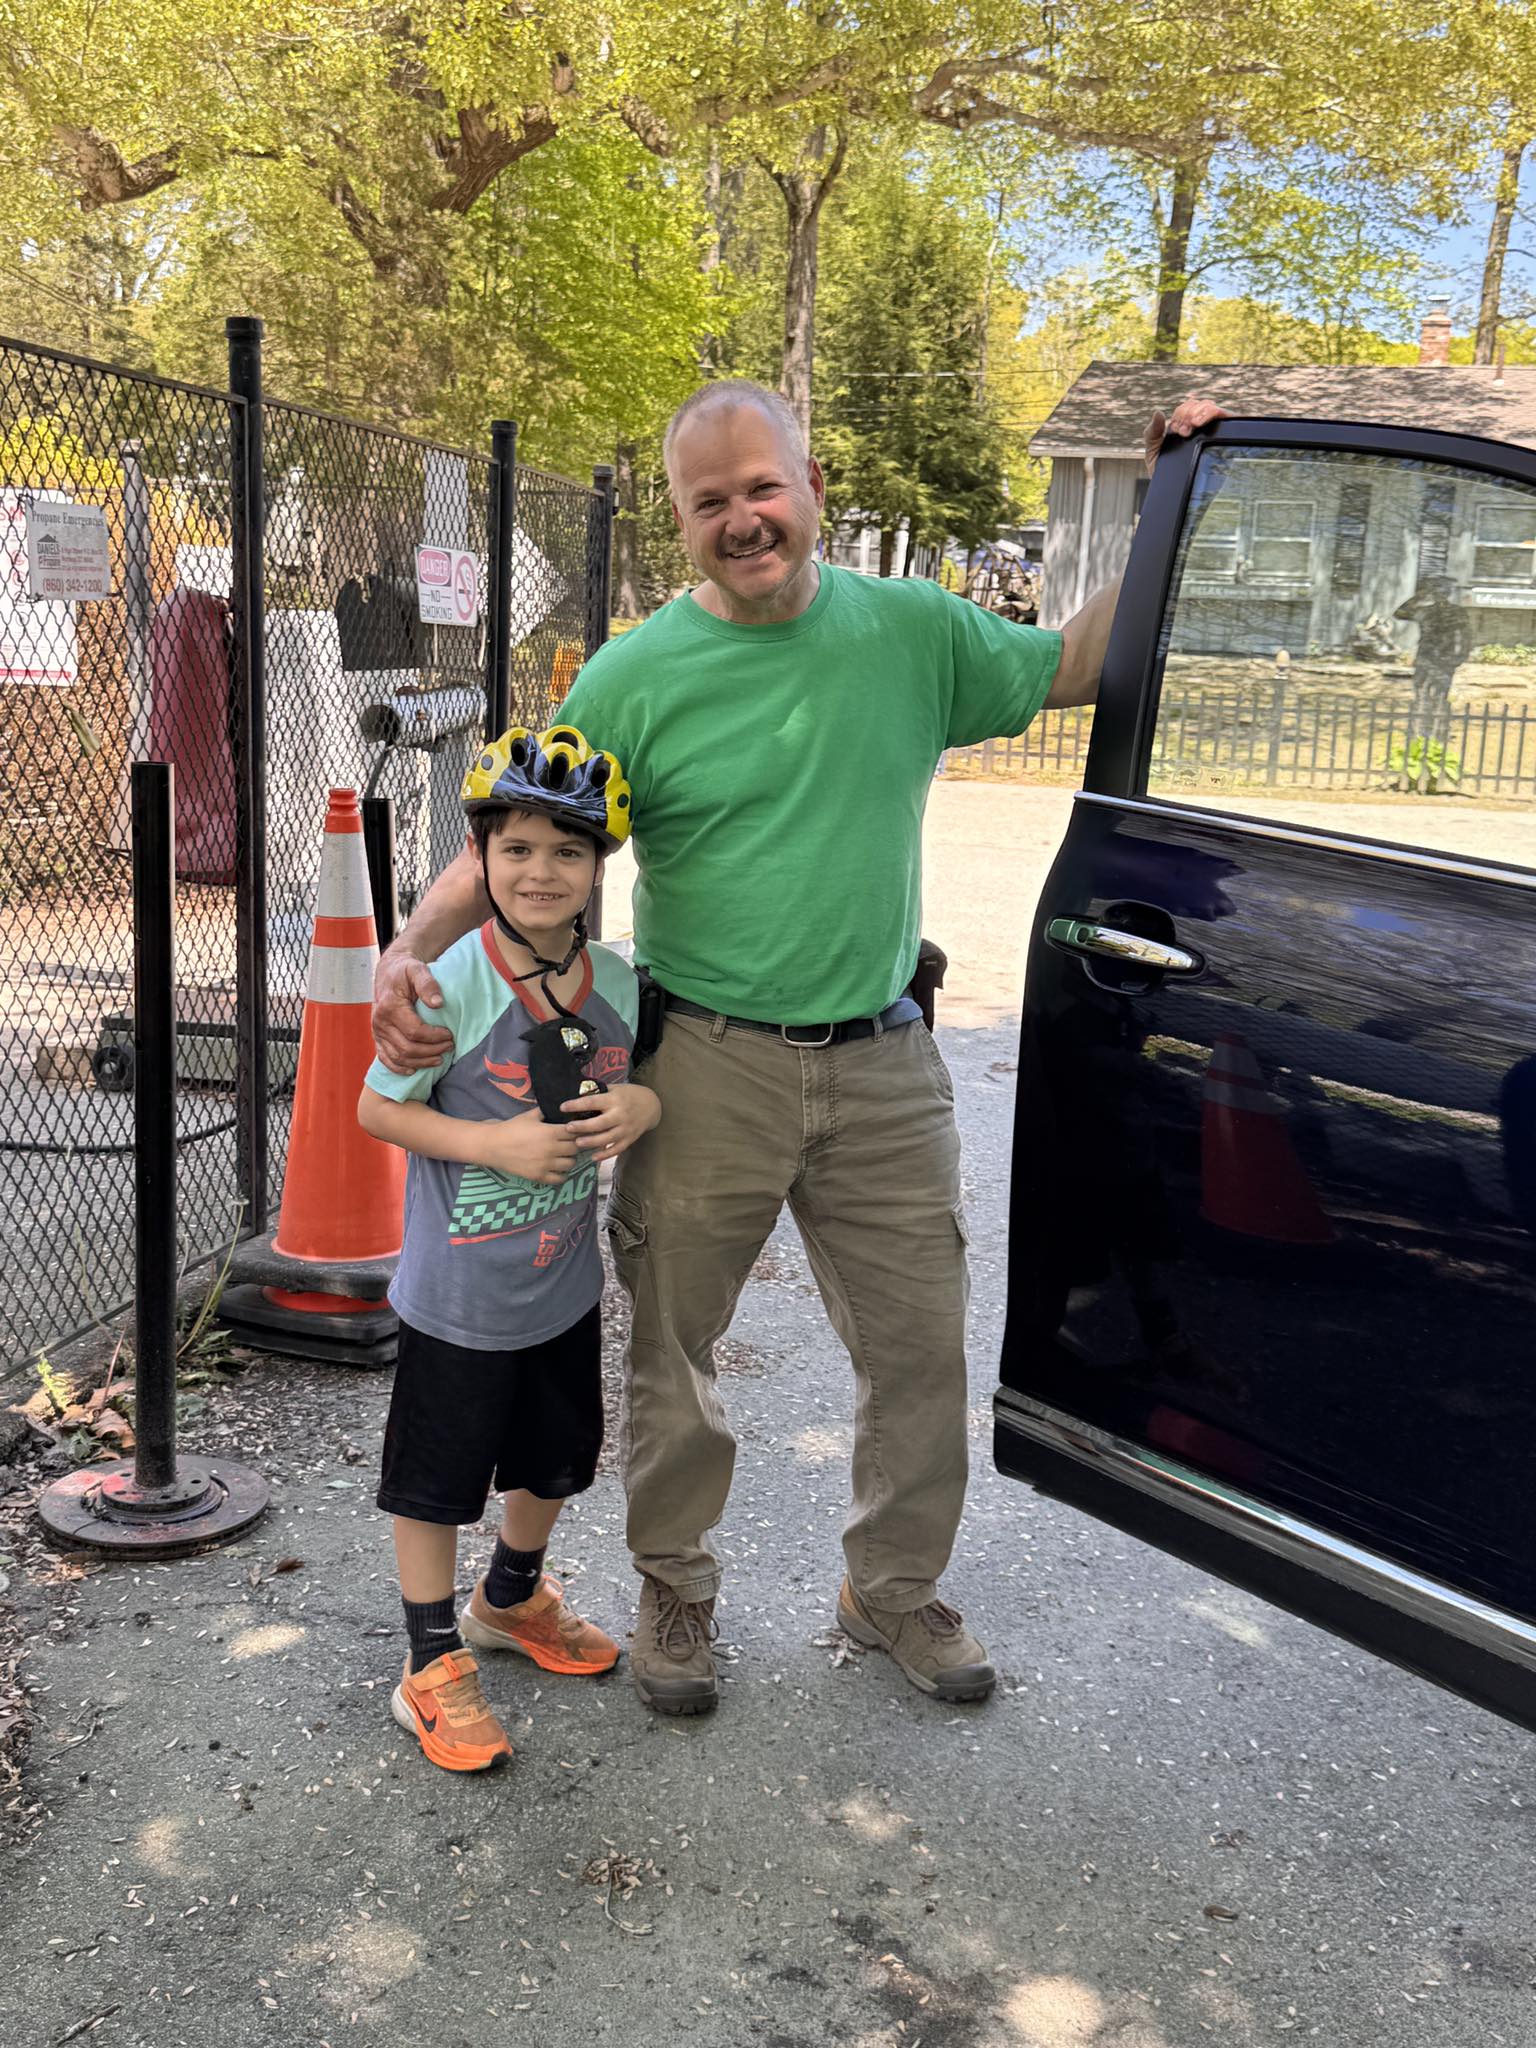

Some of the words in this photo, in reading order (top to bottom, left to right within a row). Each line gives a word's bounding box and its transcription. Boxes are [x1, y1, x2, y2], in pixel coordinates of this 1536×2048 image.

[31, 511, 61, 526] Propane
[62, 512, 104, 527] Emergencies
[37, 543, 60, 555] DANIELS
[66, 578, 102, 593] 342-1200
[430, 590, 441, 602] NO
[421, 604, 453, 620] SMOKING
